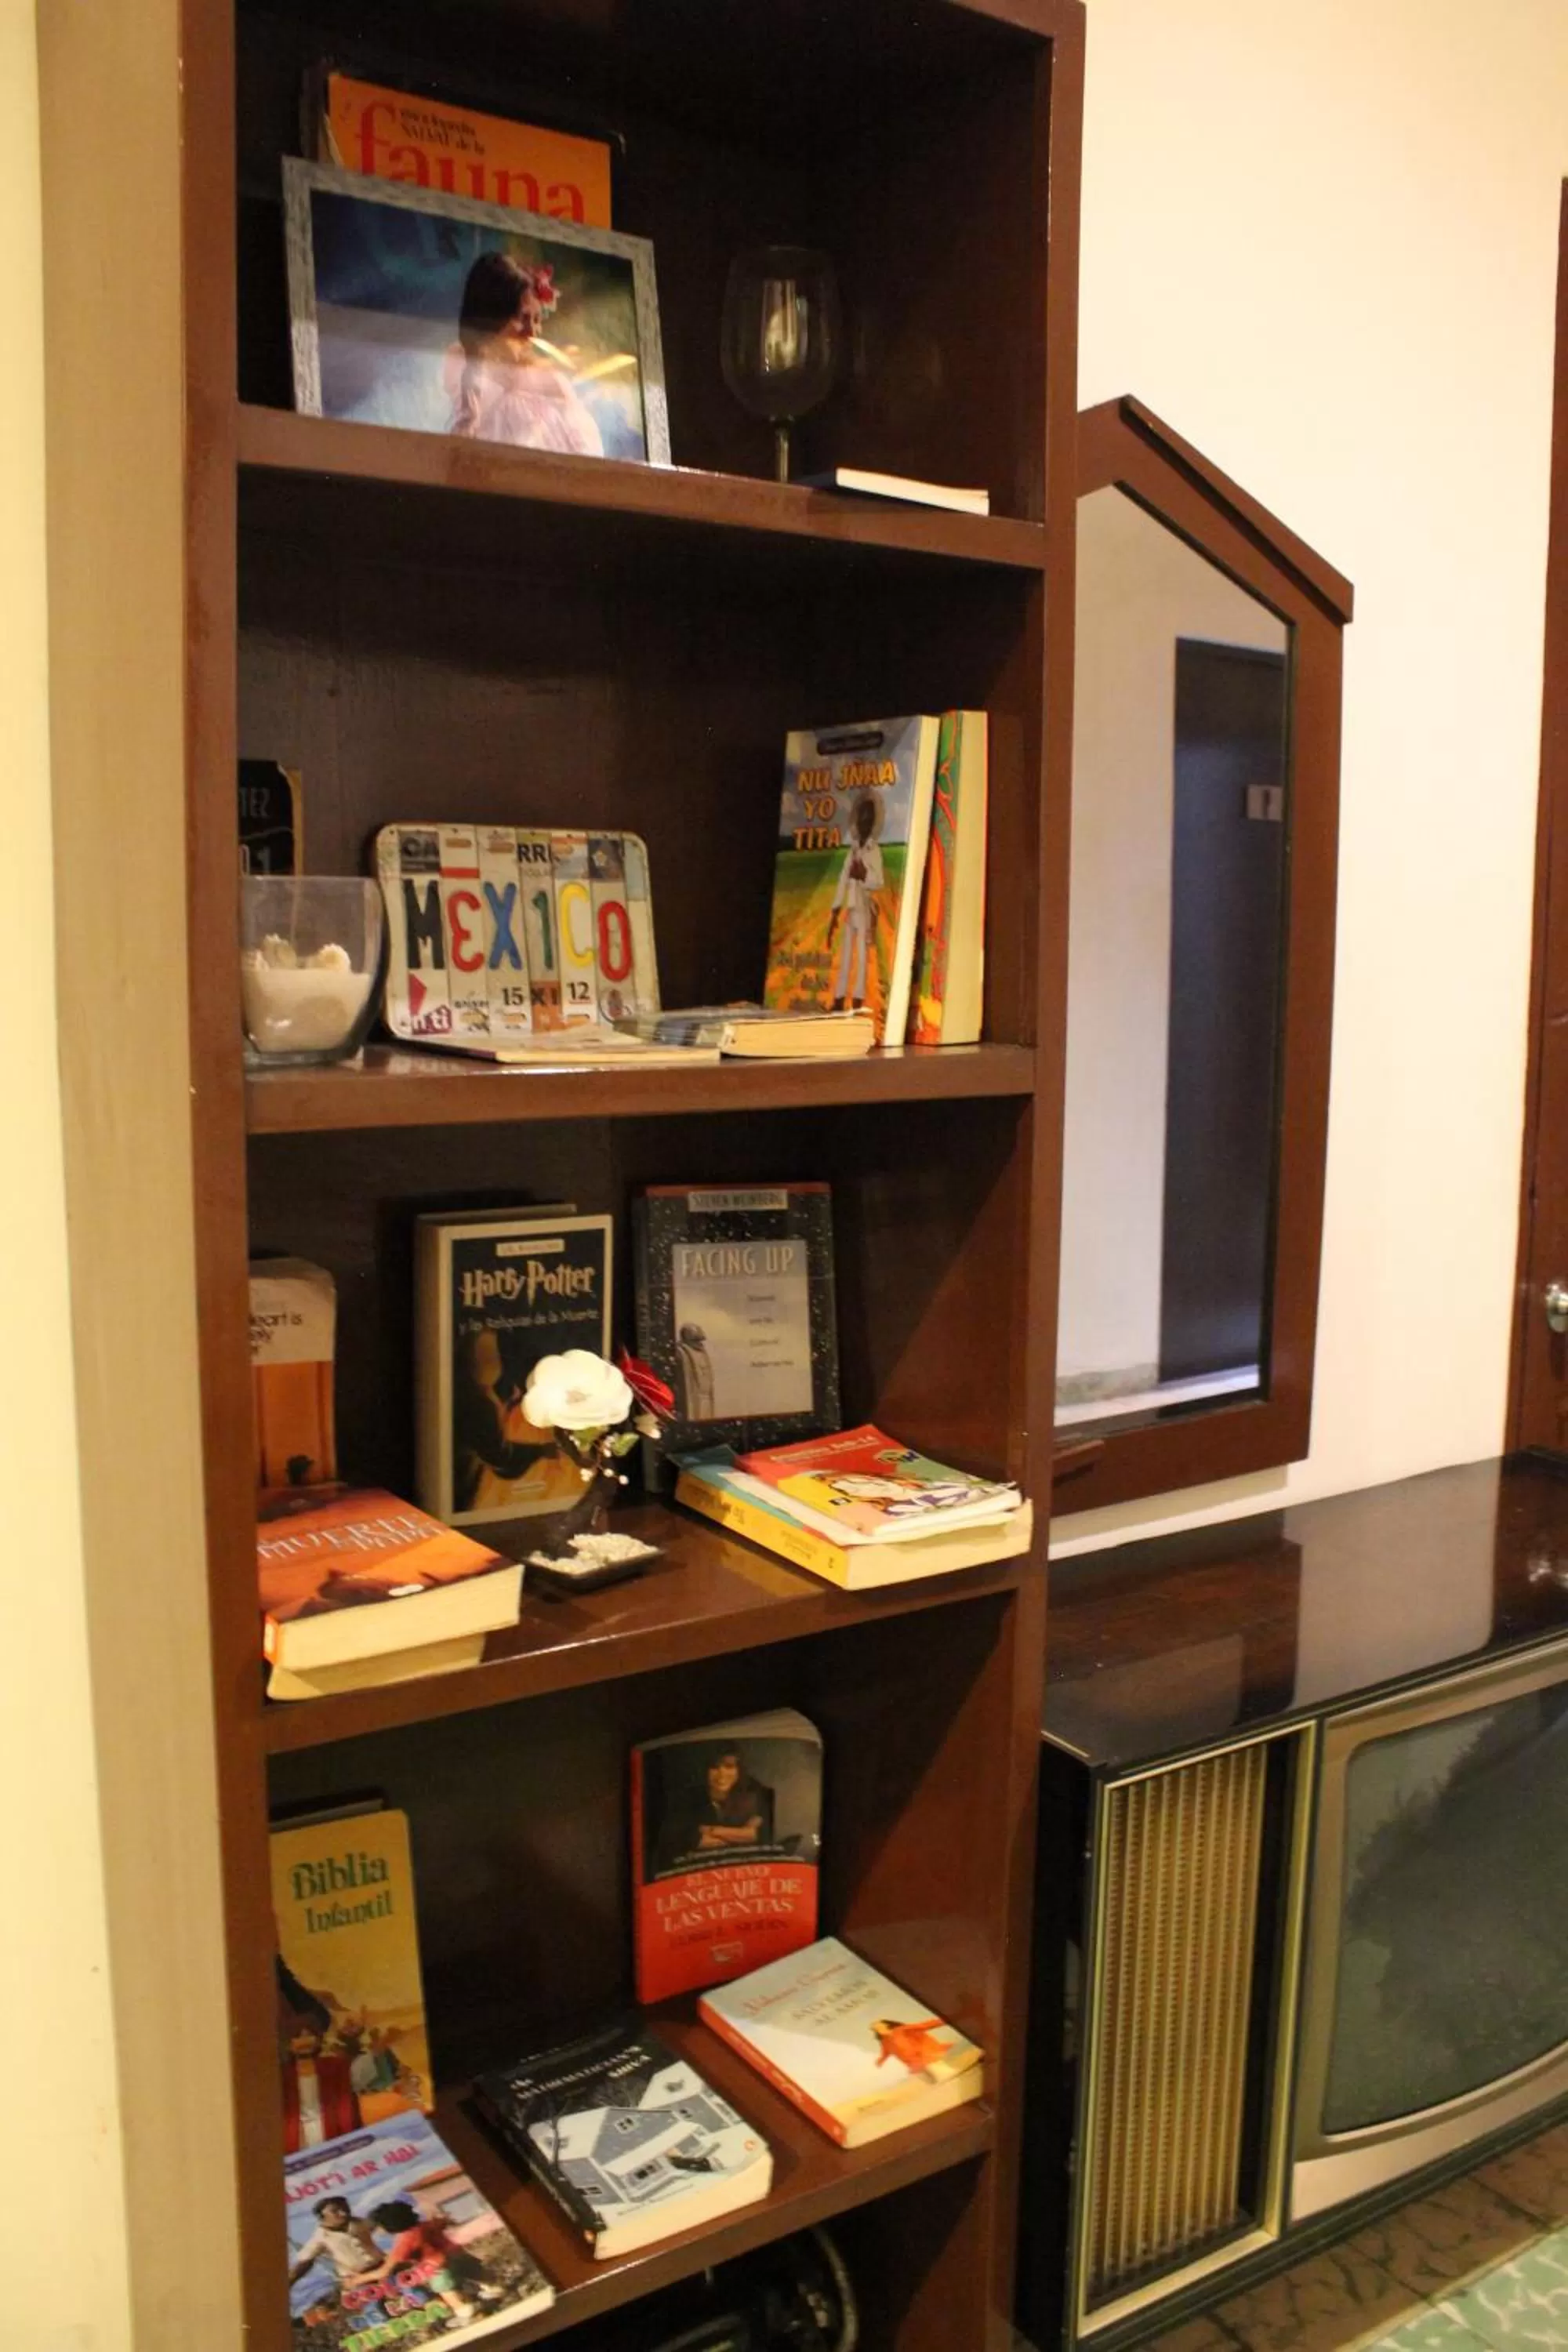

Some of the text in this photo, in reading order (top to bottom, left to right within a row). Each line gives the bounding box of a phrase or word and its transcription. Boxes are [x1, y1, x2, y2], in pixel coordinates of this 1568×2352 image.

[355, 100, 586, 223] fauna
[804, 796, 836, 821] YO
[502, 987, 524, 1006] 15
[566, 982, 591, 1000] 12
[681, 1245, 794, 1277] FACING UP
[459, 1260, 597, 1308] Harry Potter
[292, 1851, 390, 1900] Biblia
[769, 1878, 804, 1895] DE
[304, 1890, 394, 1933] Infantil
[663, 1898, 795, 1932] LAS VENTAS
[339, 2300, 452, 2352] TIERRA
